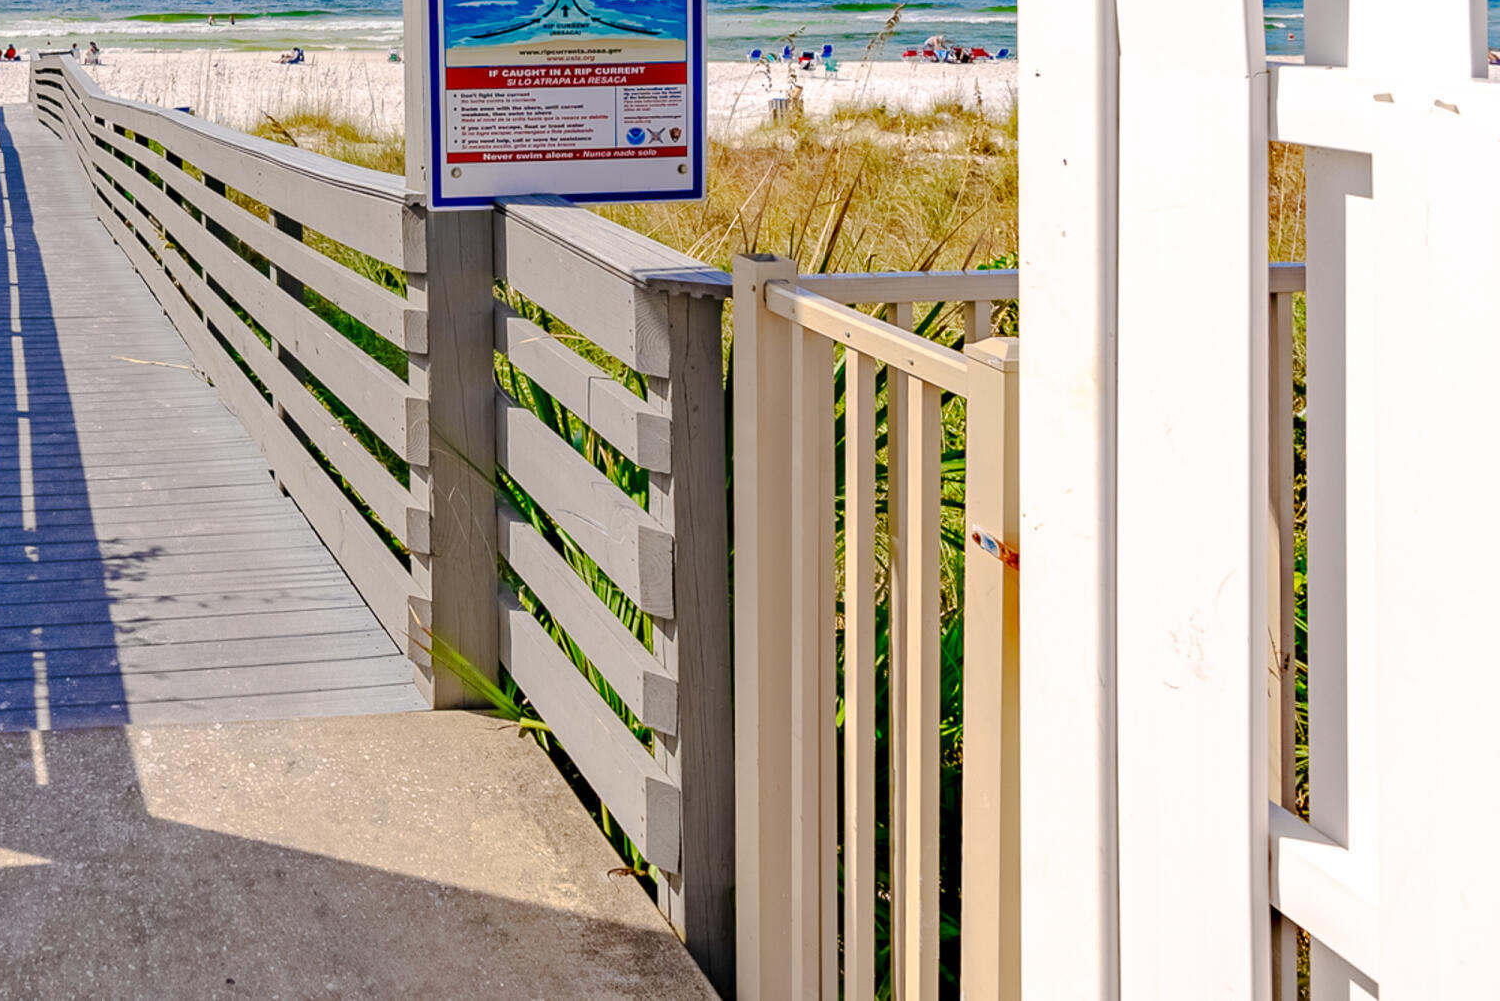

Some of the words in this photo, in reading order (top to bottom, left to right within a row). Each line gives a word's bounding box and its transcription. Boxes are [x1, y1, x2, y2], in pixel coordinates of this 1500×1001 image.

[502, 69, 546, 77] CAUGHT
[595, 66, 645, 75] CURRENT
[507, 78, 516, 86] SI
[518, 78, 532, 86] LO
[533, 77, 570, 85] ATRAPA
[587, 76, 627, 84] RESACA
[545, 151, 573, 159] alone
